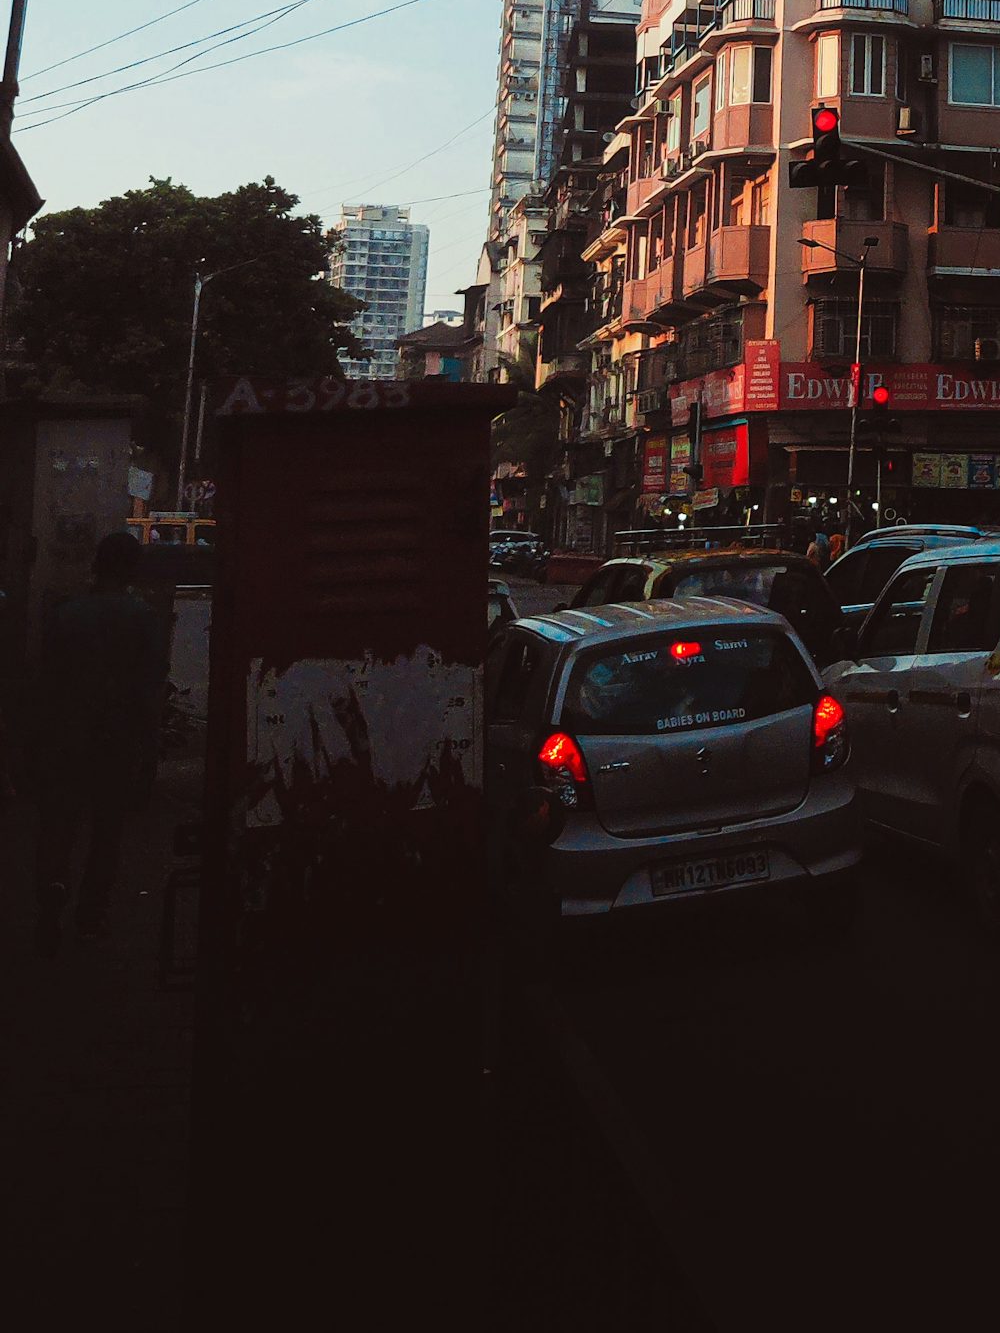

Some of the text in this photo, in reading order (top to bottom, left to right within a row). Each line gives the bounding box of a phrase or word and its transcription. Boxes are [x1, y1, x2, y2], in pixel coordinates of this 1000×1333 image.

[714, 639, 749, 652] Sanvi
[621, 650, 659, 666] Aarav
[656, 707, 747, 731] BABIES ON BOARD
